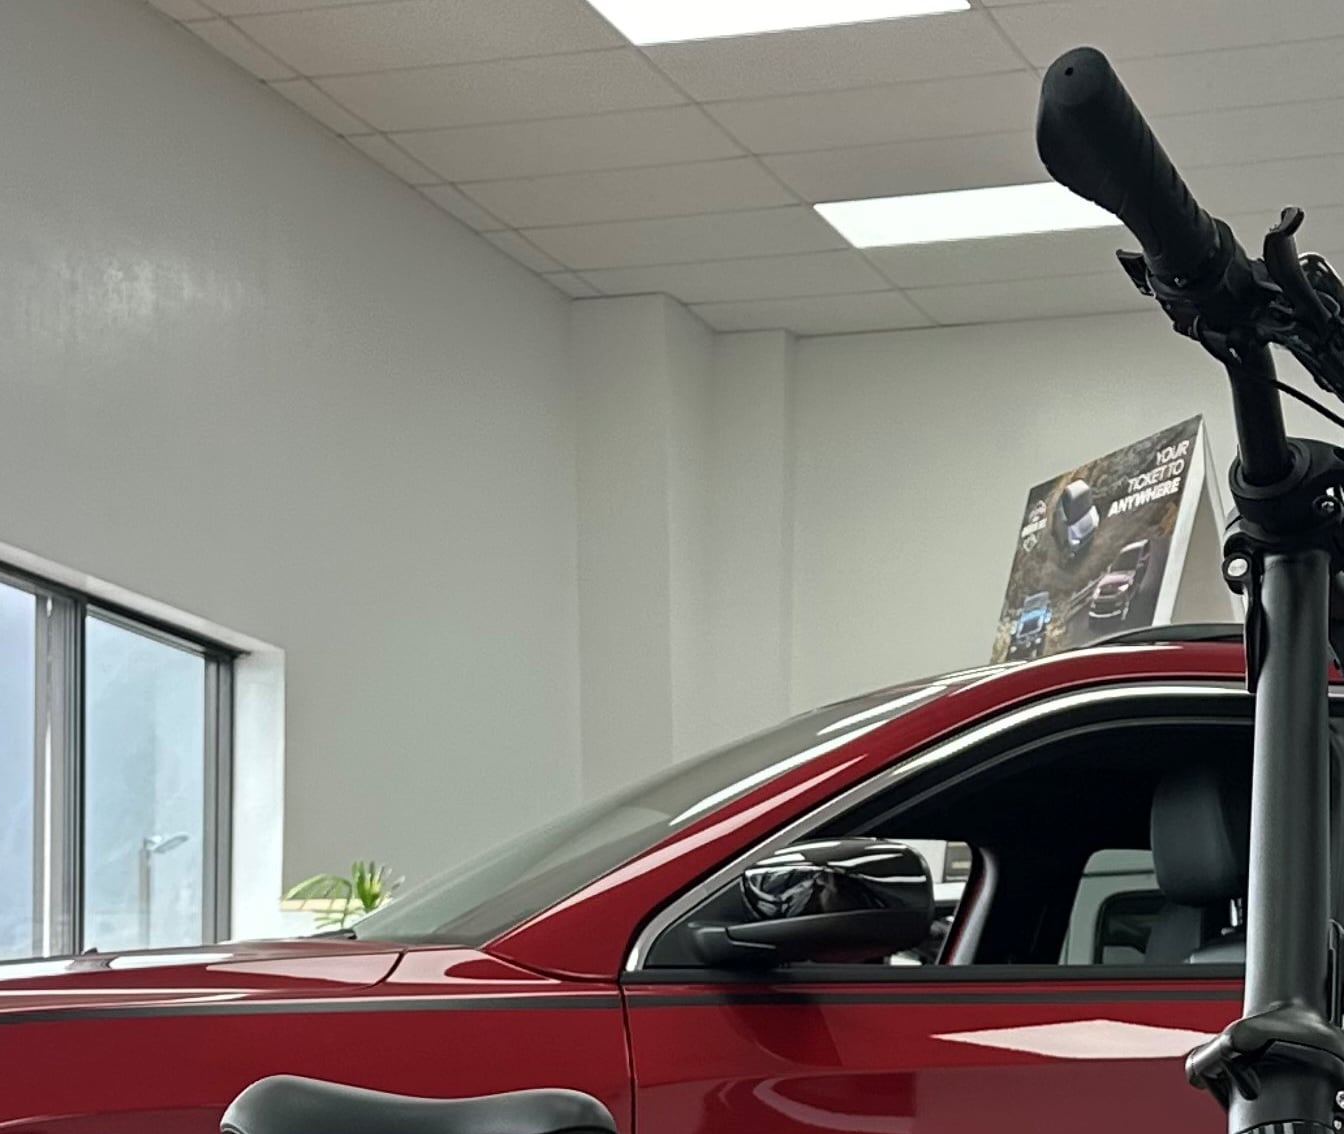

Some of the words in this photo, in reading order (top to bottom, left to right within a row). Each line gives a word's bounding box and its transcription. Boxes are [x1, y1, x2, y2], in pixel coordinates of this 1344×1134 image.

[1157, 440, 1190, 466] YOUR
[1128, 465, 1167, 494] TICKET
[1167, 458, 1185, 478] TO
[1107, 476, 1181, 518] ANYWHERE
